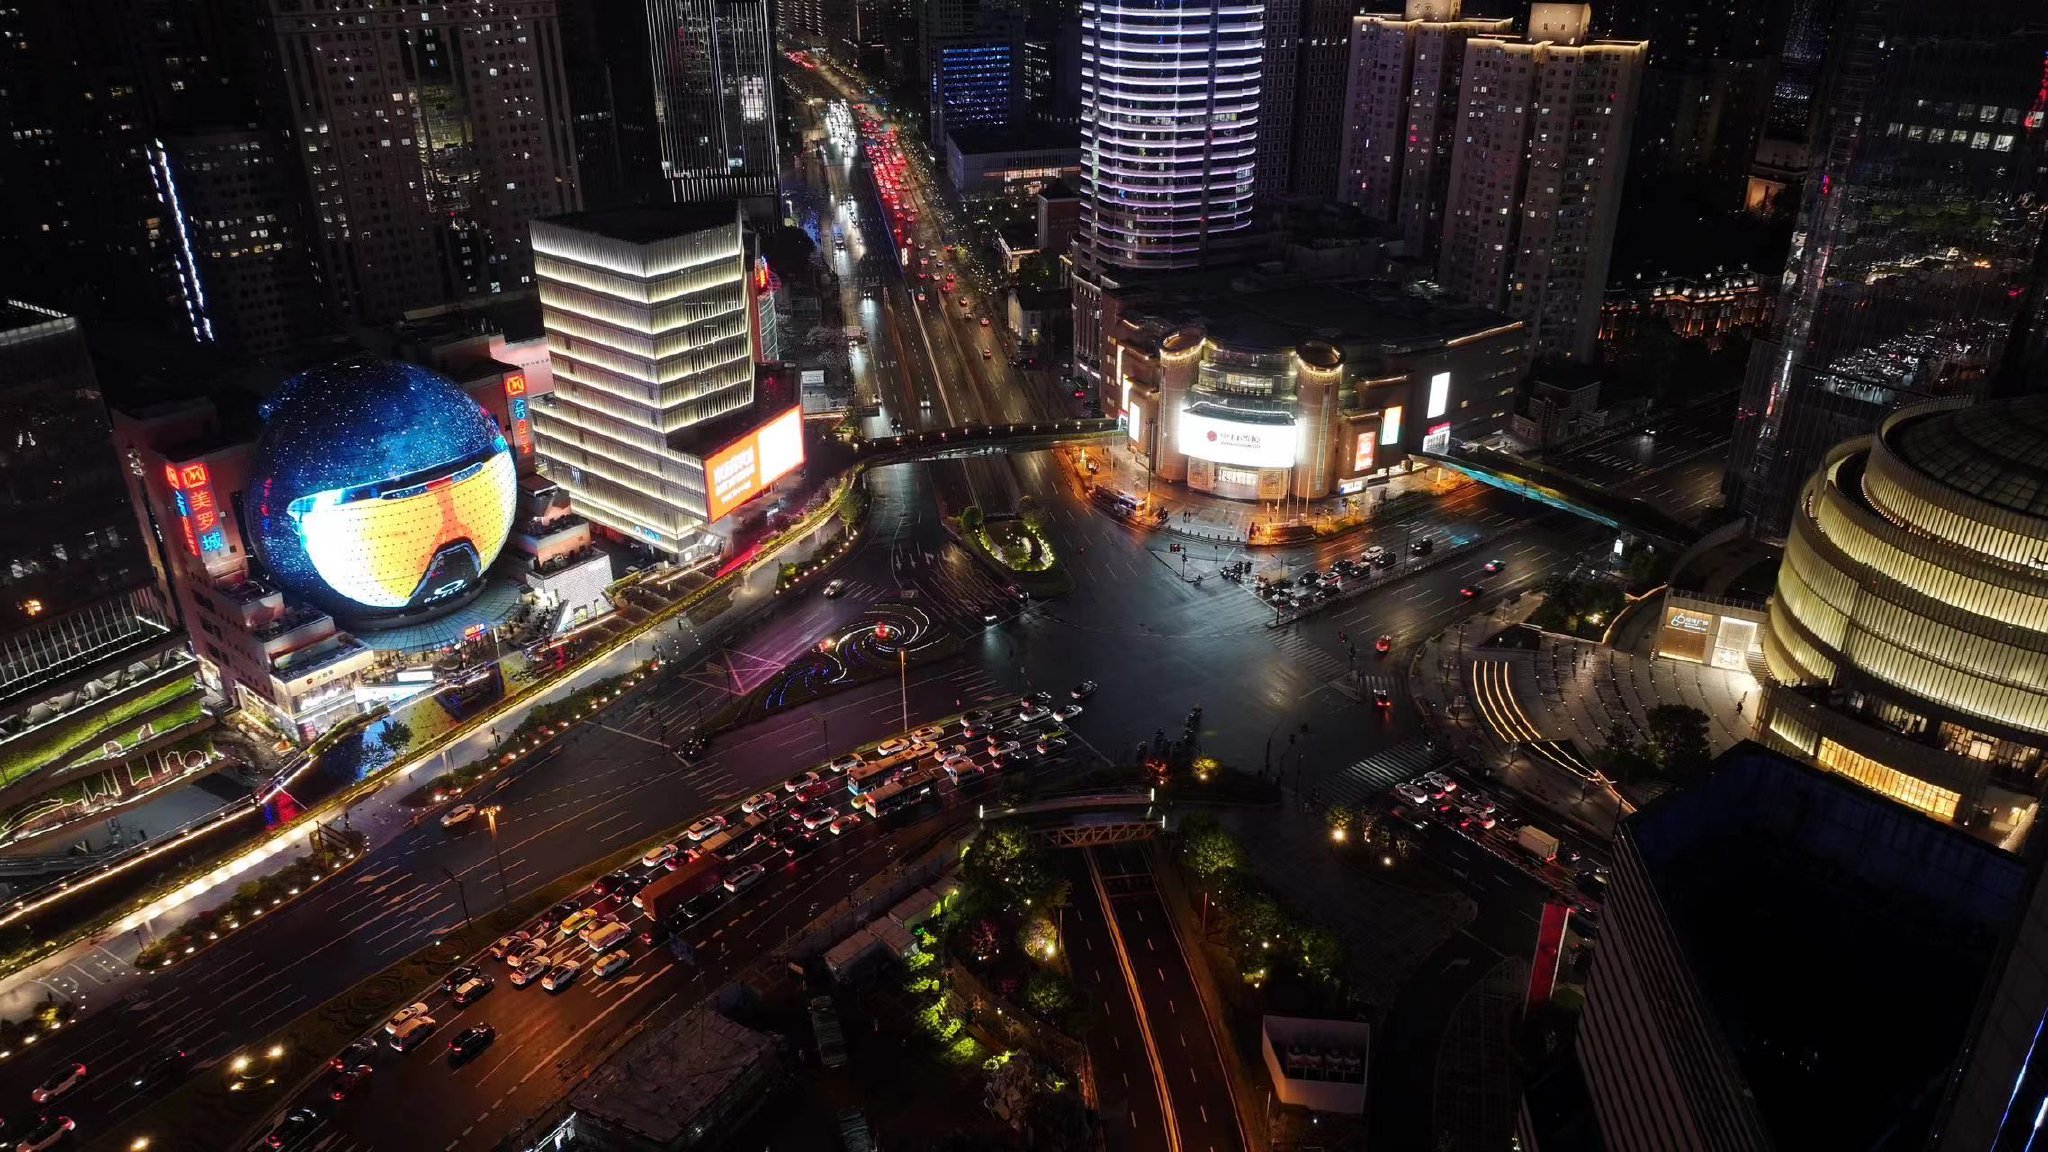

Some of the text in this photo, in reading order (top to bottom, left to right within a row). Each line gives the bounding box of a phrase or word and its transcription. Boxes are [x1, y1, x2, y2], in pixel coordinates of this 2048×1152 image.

[514, 398, 530, 454] METRO CITY
[191, 490, 223, 551] 美罗城
